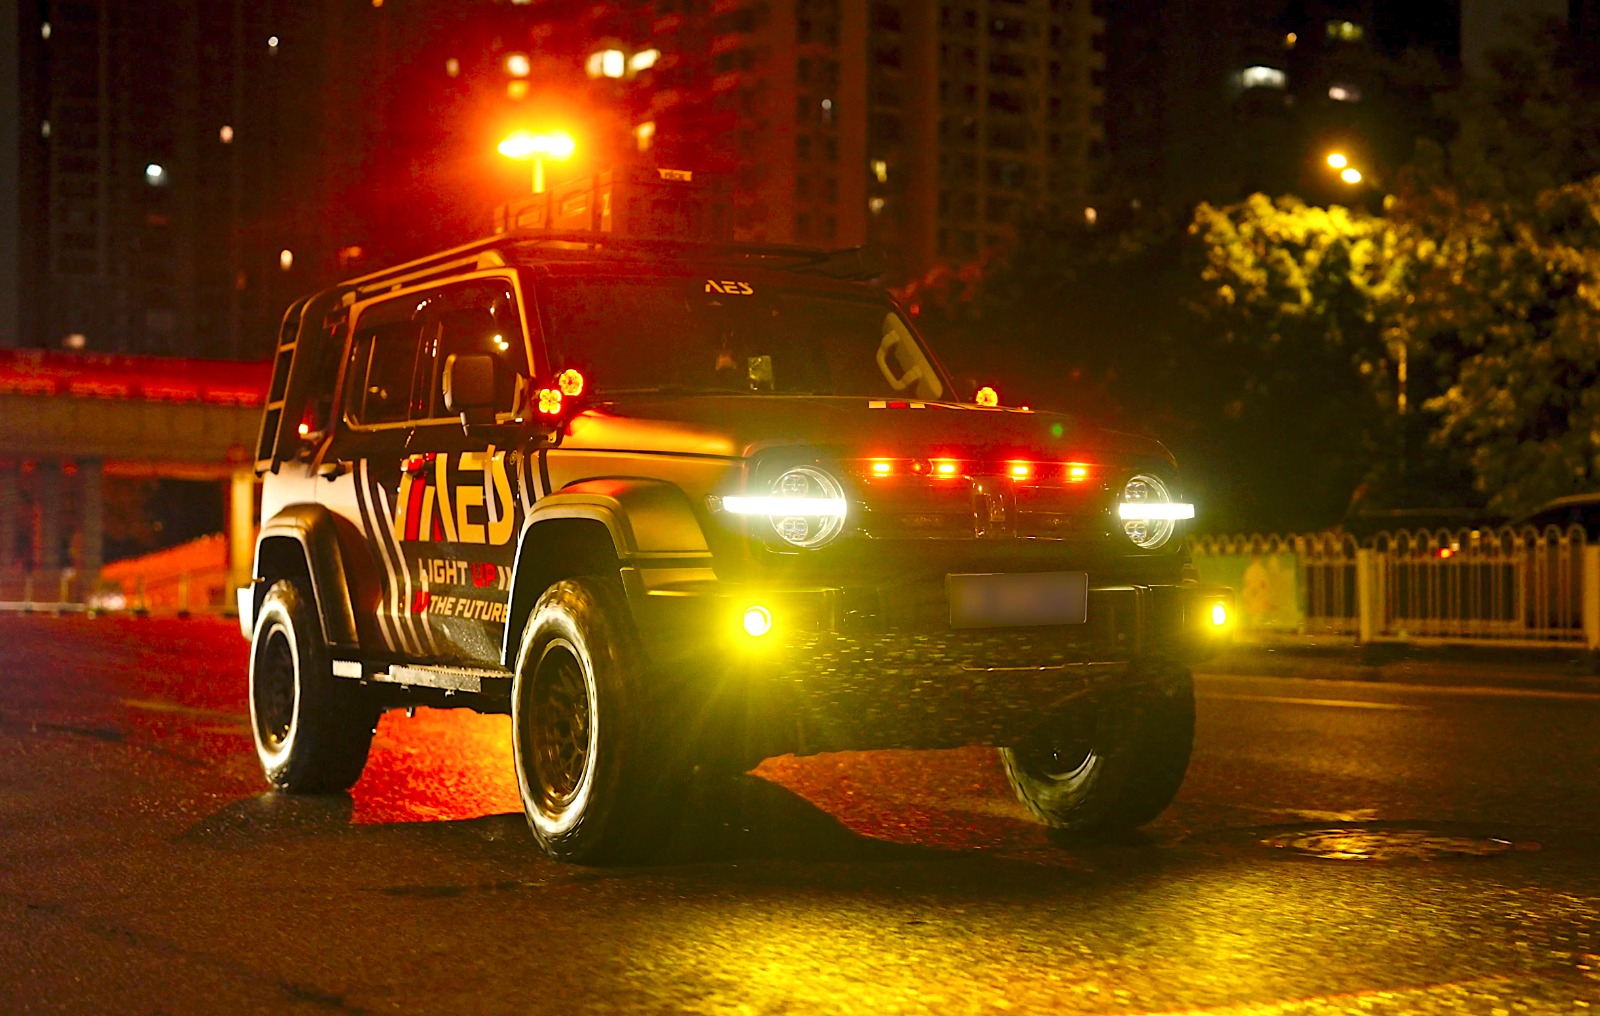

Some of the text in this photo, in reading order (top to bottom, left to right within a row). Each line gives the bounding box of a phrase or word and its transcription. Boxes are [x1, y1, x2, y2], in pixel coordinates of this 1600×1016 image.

[418, 558, 498, 588] LIGHT UP
[429, 595, 508, 623] THE FUTURE
